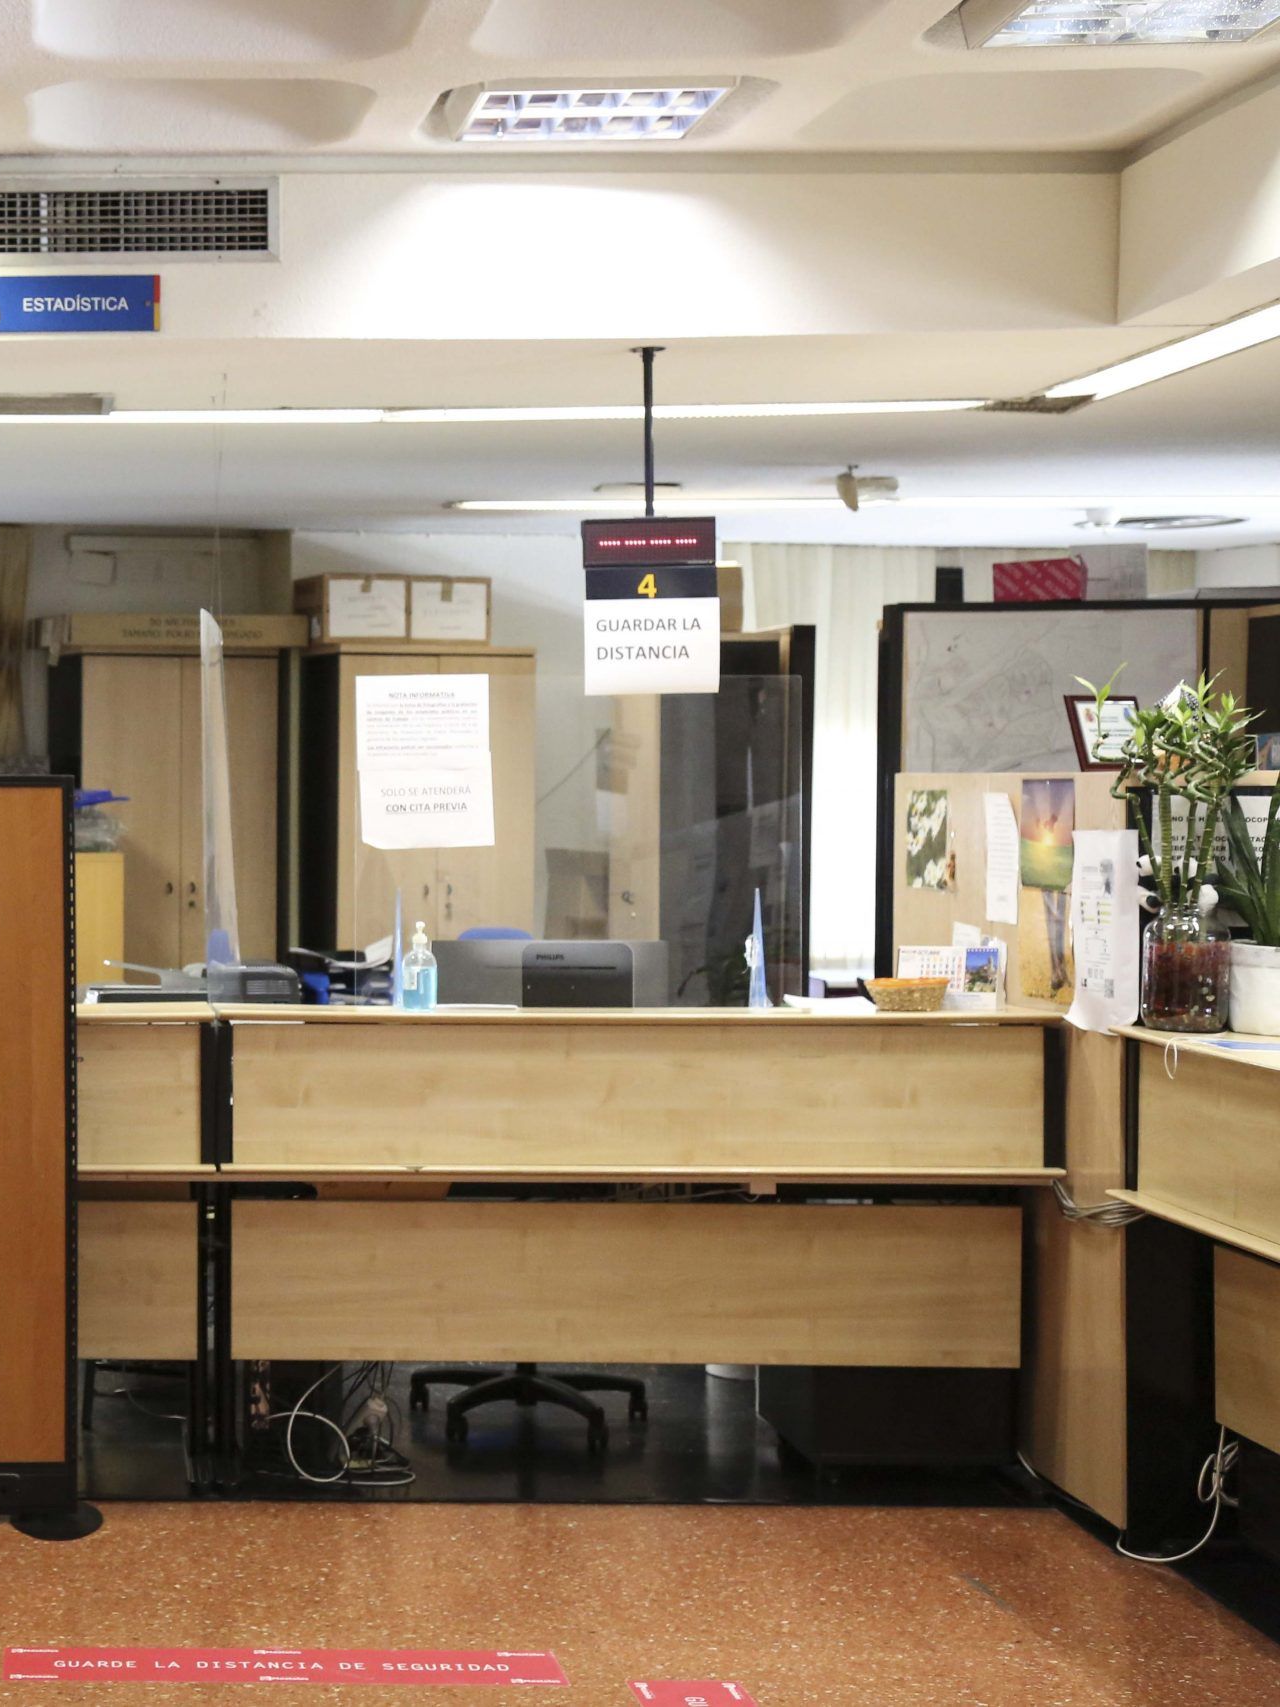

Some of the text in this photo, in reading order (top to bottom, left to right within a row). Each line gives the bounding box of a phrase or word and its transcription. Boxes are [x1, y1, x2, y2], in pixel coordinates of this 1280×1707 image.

[22, 294, 129, 312] ESTADÍSTICA
[637, 573, 657, 599] 4
[596, 617, 702, 632] GUARDAR LA
[597, 645, 690, 661] DISTANCIA
[381, 784, 472, 797] SOLO SE ATENDERÁ
[386, 802, 468, 813] CON CITA PREVIA
[54, 1660, 510, 1672] GUARDE LA DISTANCIA DE SEGURIDAD
